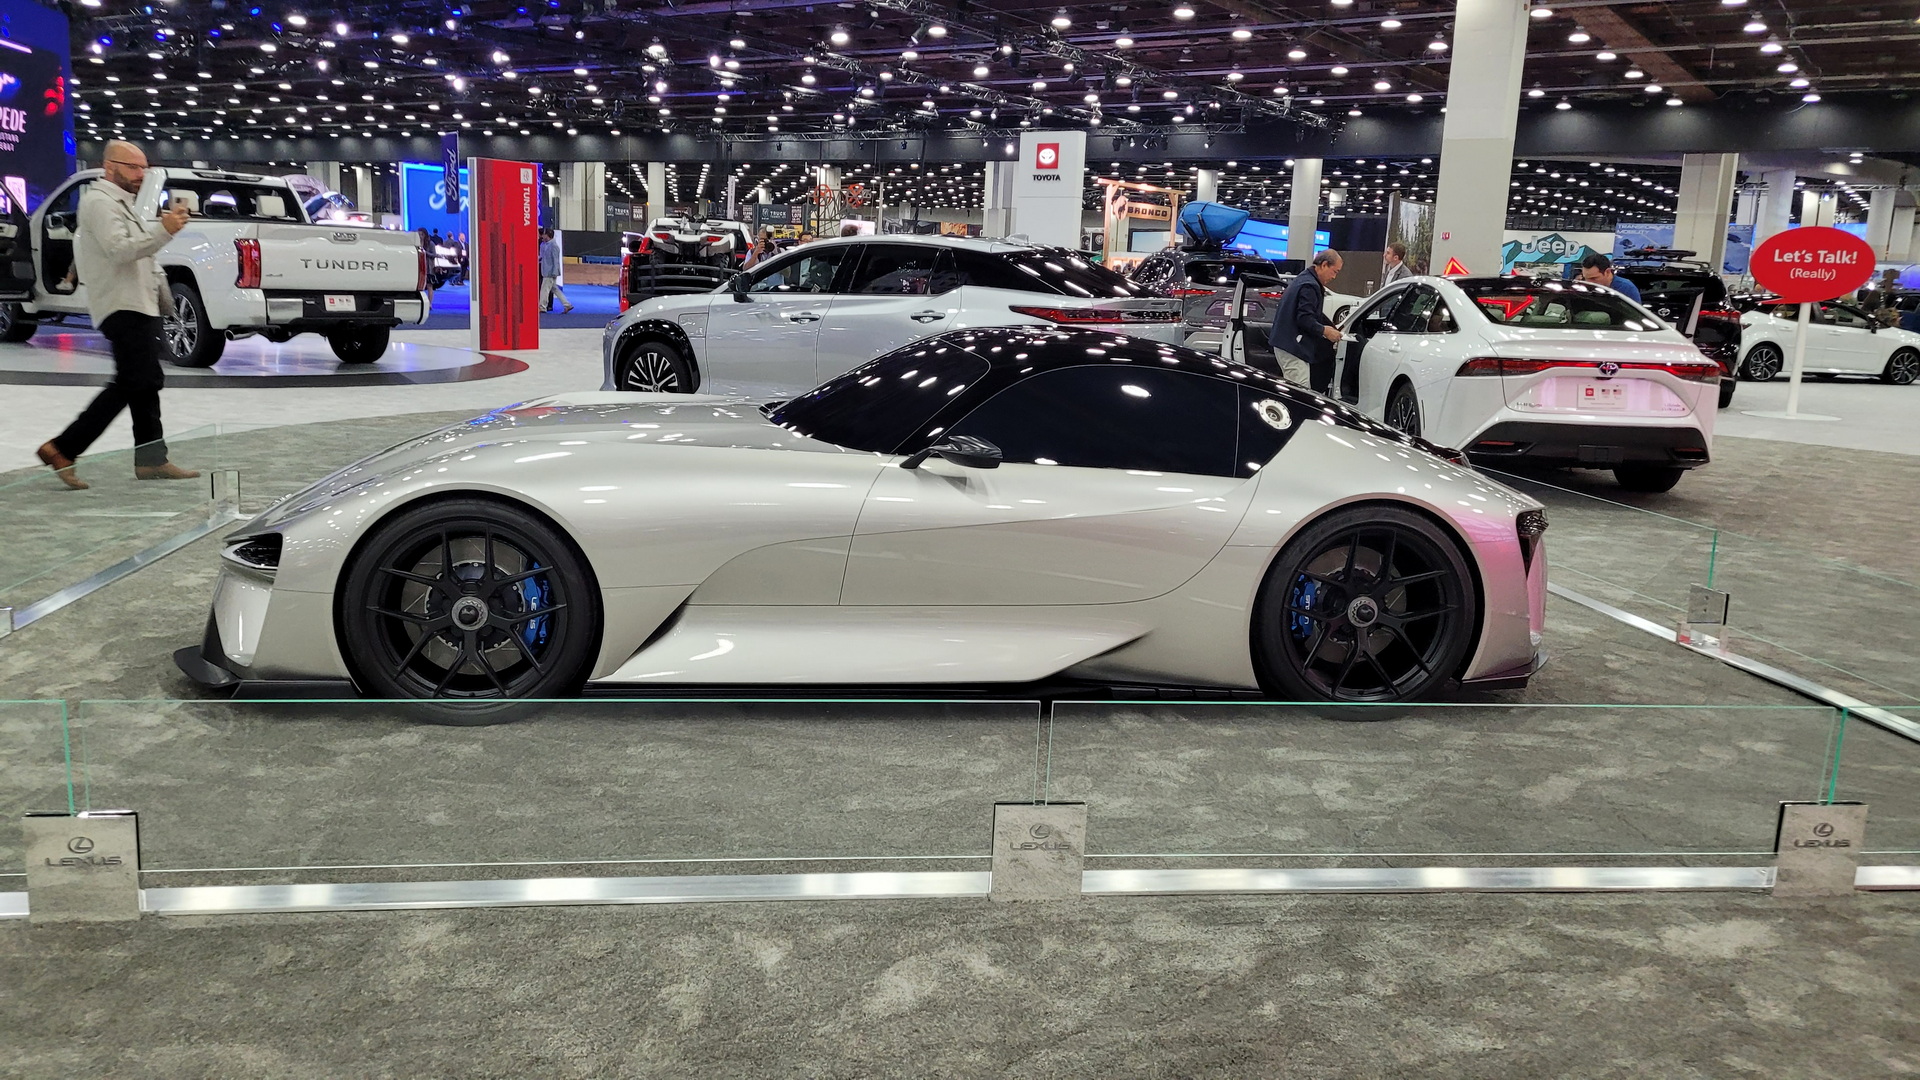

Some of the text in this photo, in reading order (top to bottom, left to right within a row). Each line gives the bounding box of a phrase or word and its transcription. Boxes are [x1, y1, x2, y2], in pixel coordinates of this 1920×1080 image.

[445, 148, 457, 201] Ford
[523, 186, 531, 226] TUNDRA
[1127, 206, 1168, 217] BRONCO
[1521, 235, 1580, 258] Jeep
[1774, 249, 1858, 264] Let's Talk!
[300, 258, 389, 271] TUNDRA
[1790, 267, 1837, 281] (Really)
[1009, 841, 1072, 852] LEXUS
[1793, 839, 1851, 848] LEXUS
[44, 856, 122, 868] LEXUS
